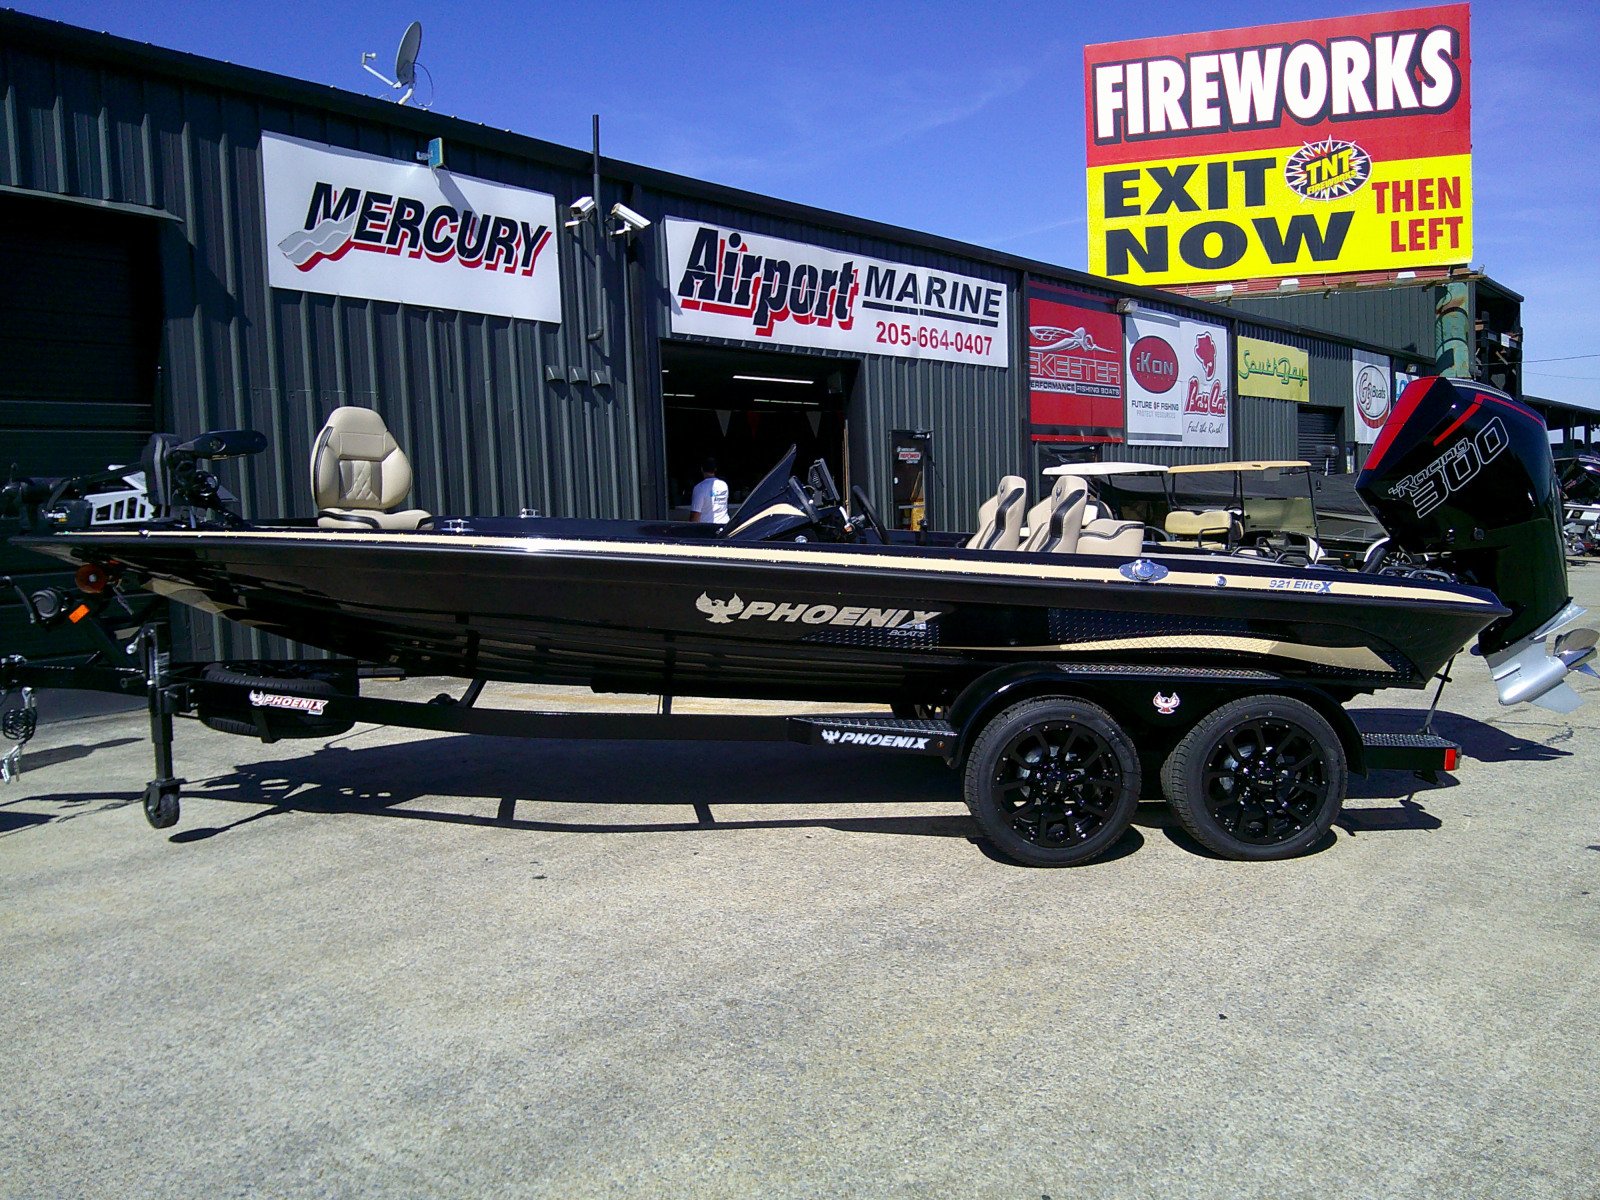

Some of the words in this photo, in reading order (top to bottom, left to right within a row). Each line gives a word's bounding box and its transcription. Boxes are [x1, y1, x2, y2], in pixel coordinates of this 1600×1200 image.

[1094, 27, 1458, 141] FIREWORKS
[1306, 148, 1353, 186] TNT
[1307, 169, 1357, 195] FIREWORKS
[1104, 157, 1277, 218] EXIT
[1372, 176, 1461, 214] THEN
[304, 181, 549, 274] MERCURY
[1106, 211, 1355, 276] NOW
[1391, 216, 1463, 253] LEFT
[678, 226, 857, 332] Airport
[864, 265, 1003, 318] MARINE
[876, 320, 994, 356] 205-664-0407
[1029, 351, 1120, 384] SKEETER
[1030, 382, 1075, 392] ERFORMANCE
[1077, 385, 1100, 394] FISHING
[1131, 400, 1153, 410] FUTURE
[1161, 403, 1179, 411] FISHING
[1399, 438, 1470, 498] Racing
[1410, 416, 1509, 518] 300
[1269, 580, 1290, 589] 921
[738, 600, 942, 630] PHOENIX
[888, 629, 926, 638] BOATS
[263, 694, 328, 711] PHOENIX
[839, 731, 930, 750] PHOENIX
